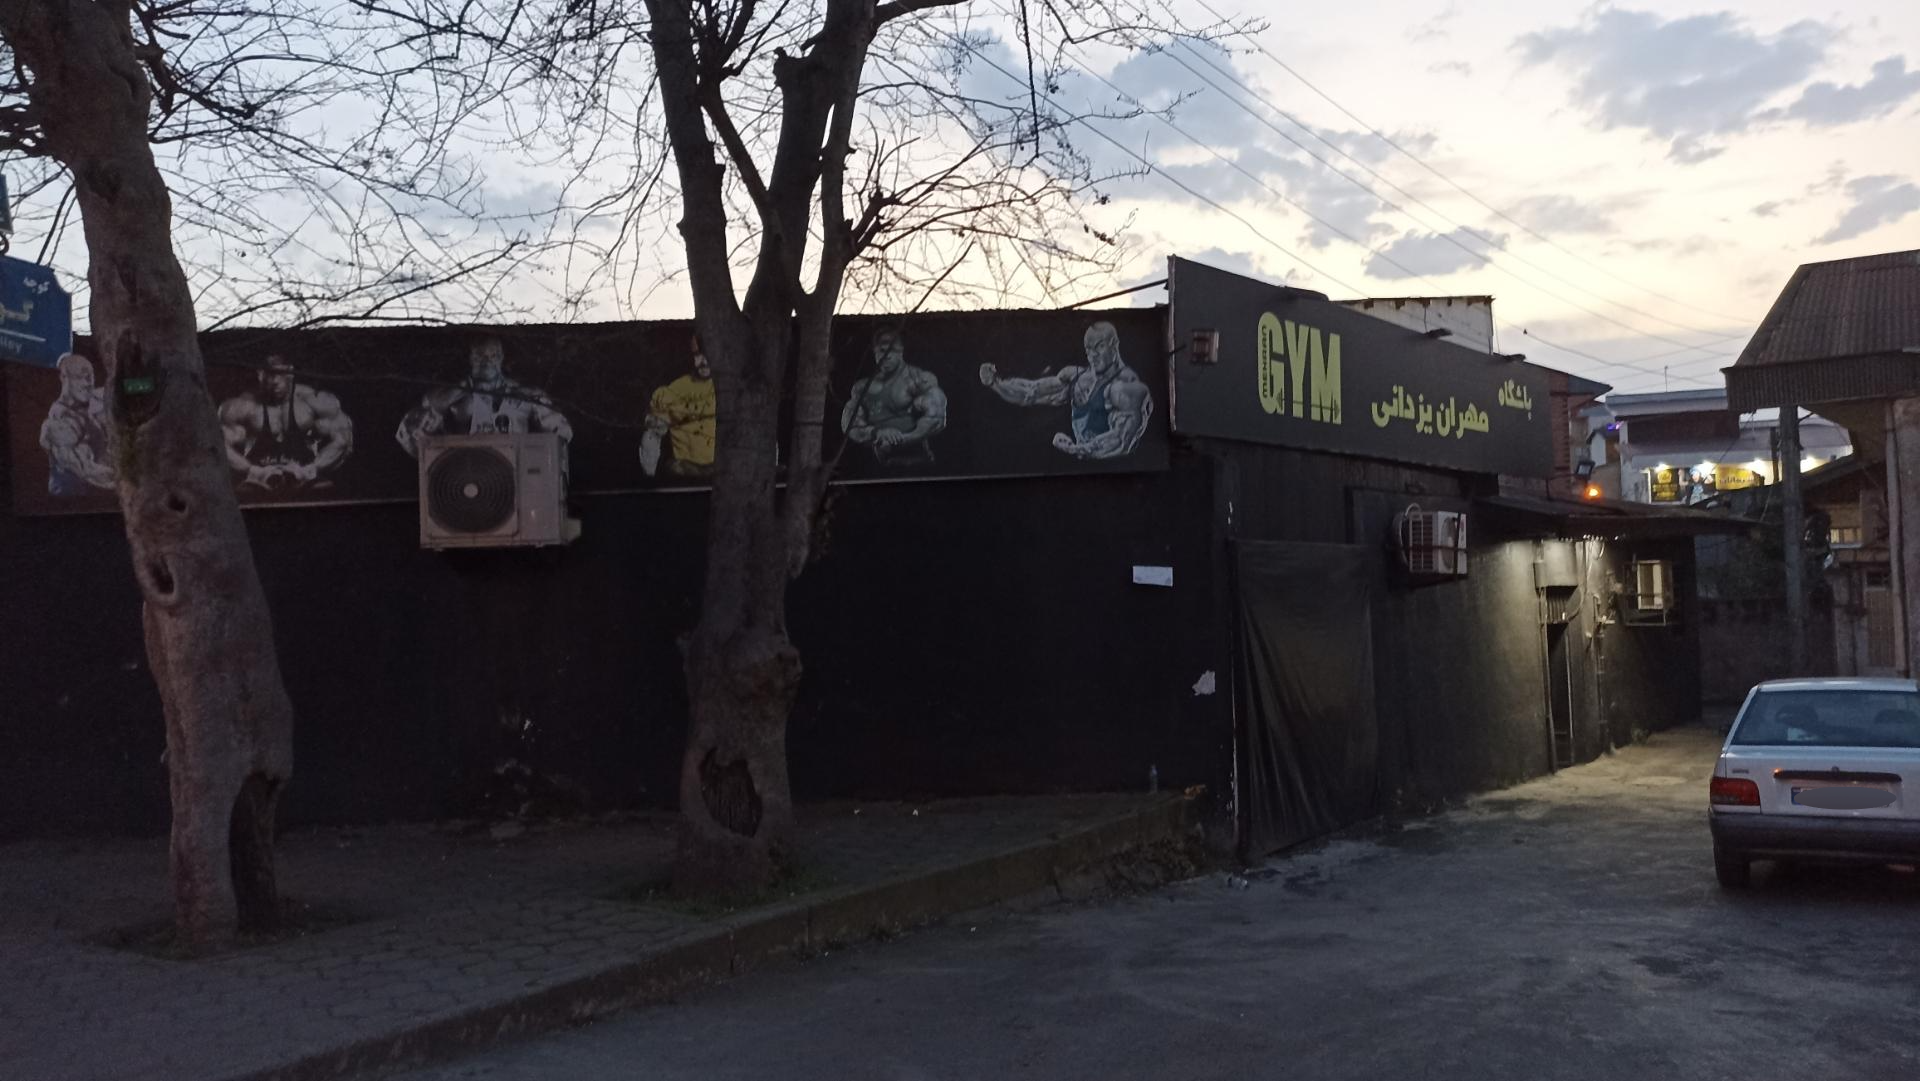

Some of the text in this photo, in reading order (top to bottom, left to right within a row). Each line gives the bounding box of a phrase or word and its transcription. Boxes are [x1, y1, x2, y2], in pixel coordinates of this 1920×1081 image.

[0, 335, 22, 353] lley
[1257, 310, 1342, 425] GYM
[1371, 377, 1532, 439] باشگاه مهران یزدانی
